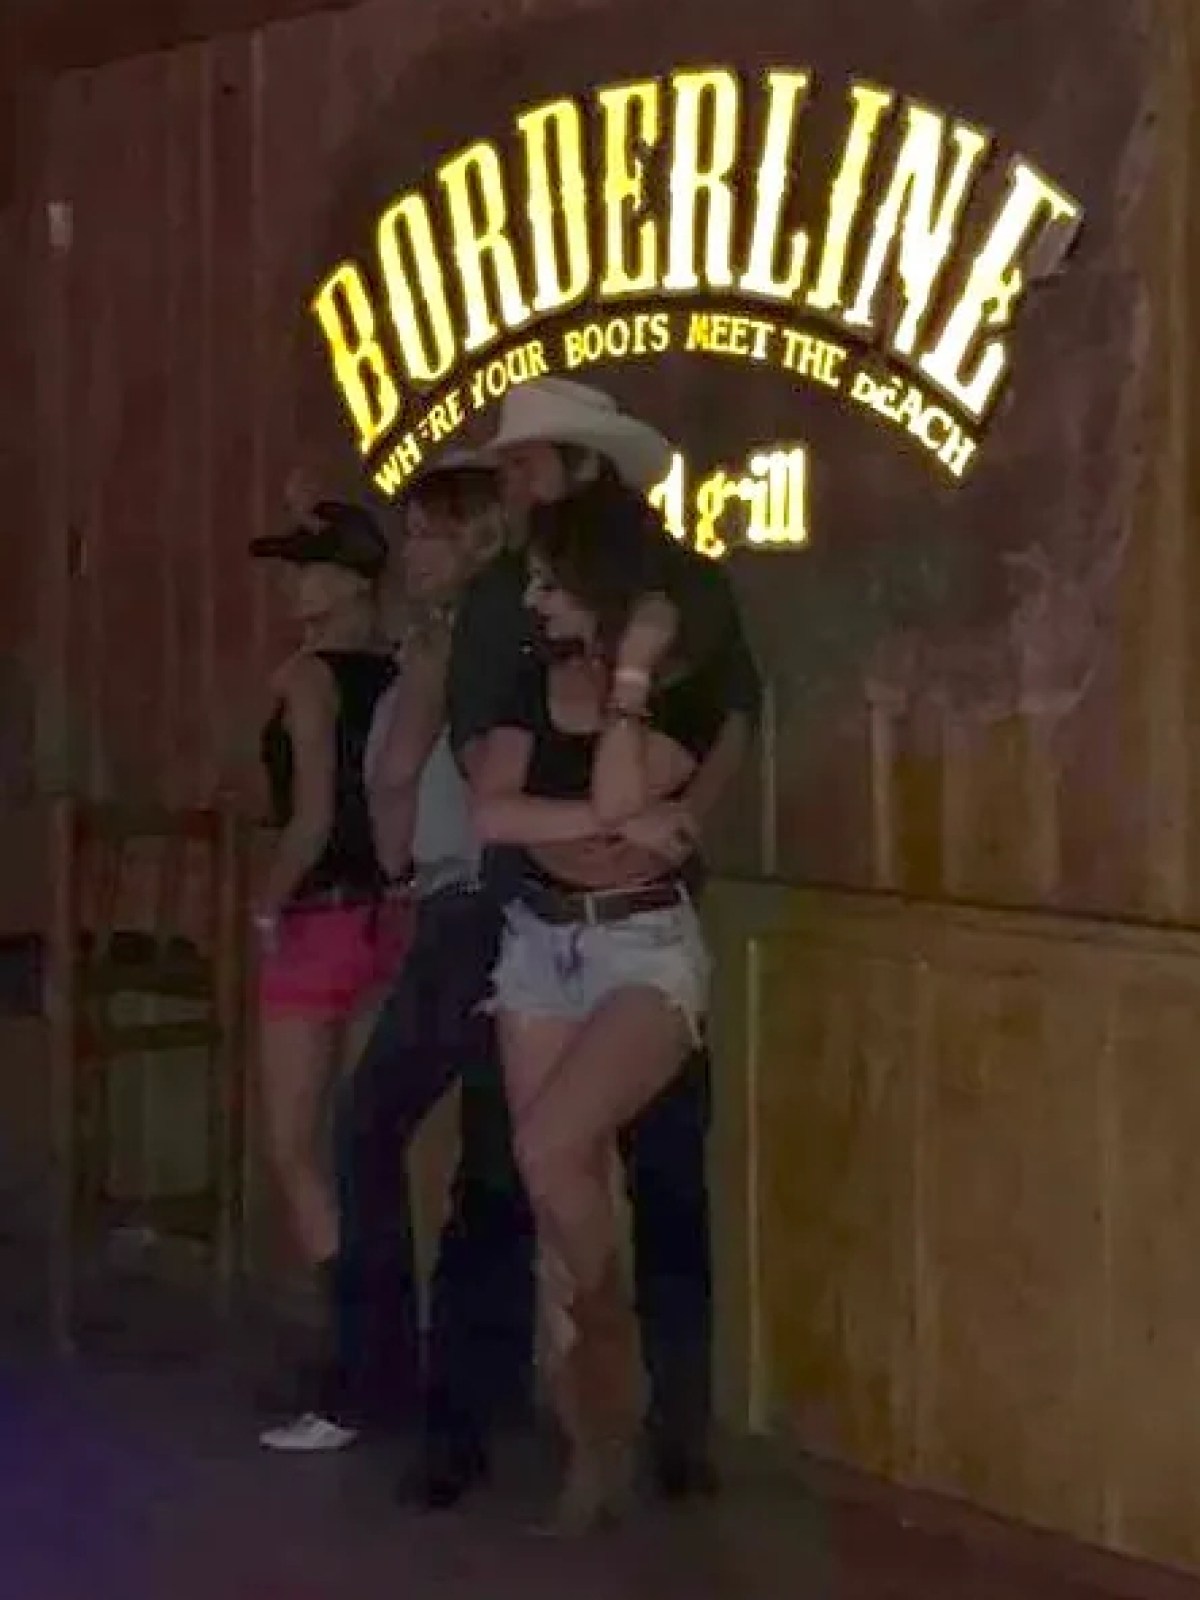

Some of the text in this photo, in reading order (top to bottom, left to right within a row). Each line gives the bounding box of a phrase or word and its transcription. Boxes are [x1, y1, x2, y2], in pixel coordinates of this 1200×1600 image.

[309, 66, 1083, 454] BORDERLINE
[470, 339, 549, 409] YOUR
[564, 312, 671, 369] BOOTS
[685, 312, 776, 361] MEET
[780, 328, 850, 388] THE
[694, 447, 807, 560] grill
